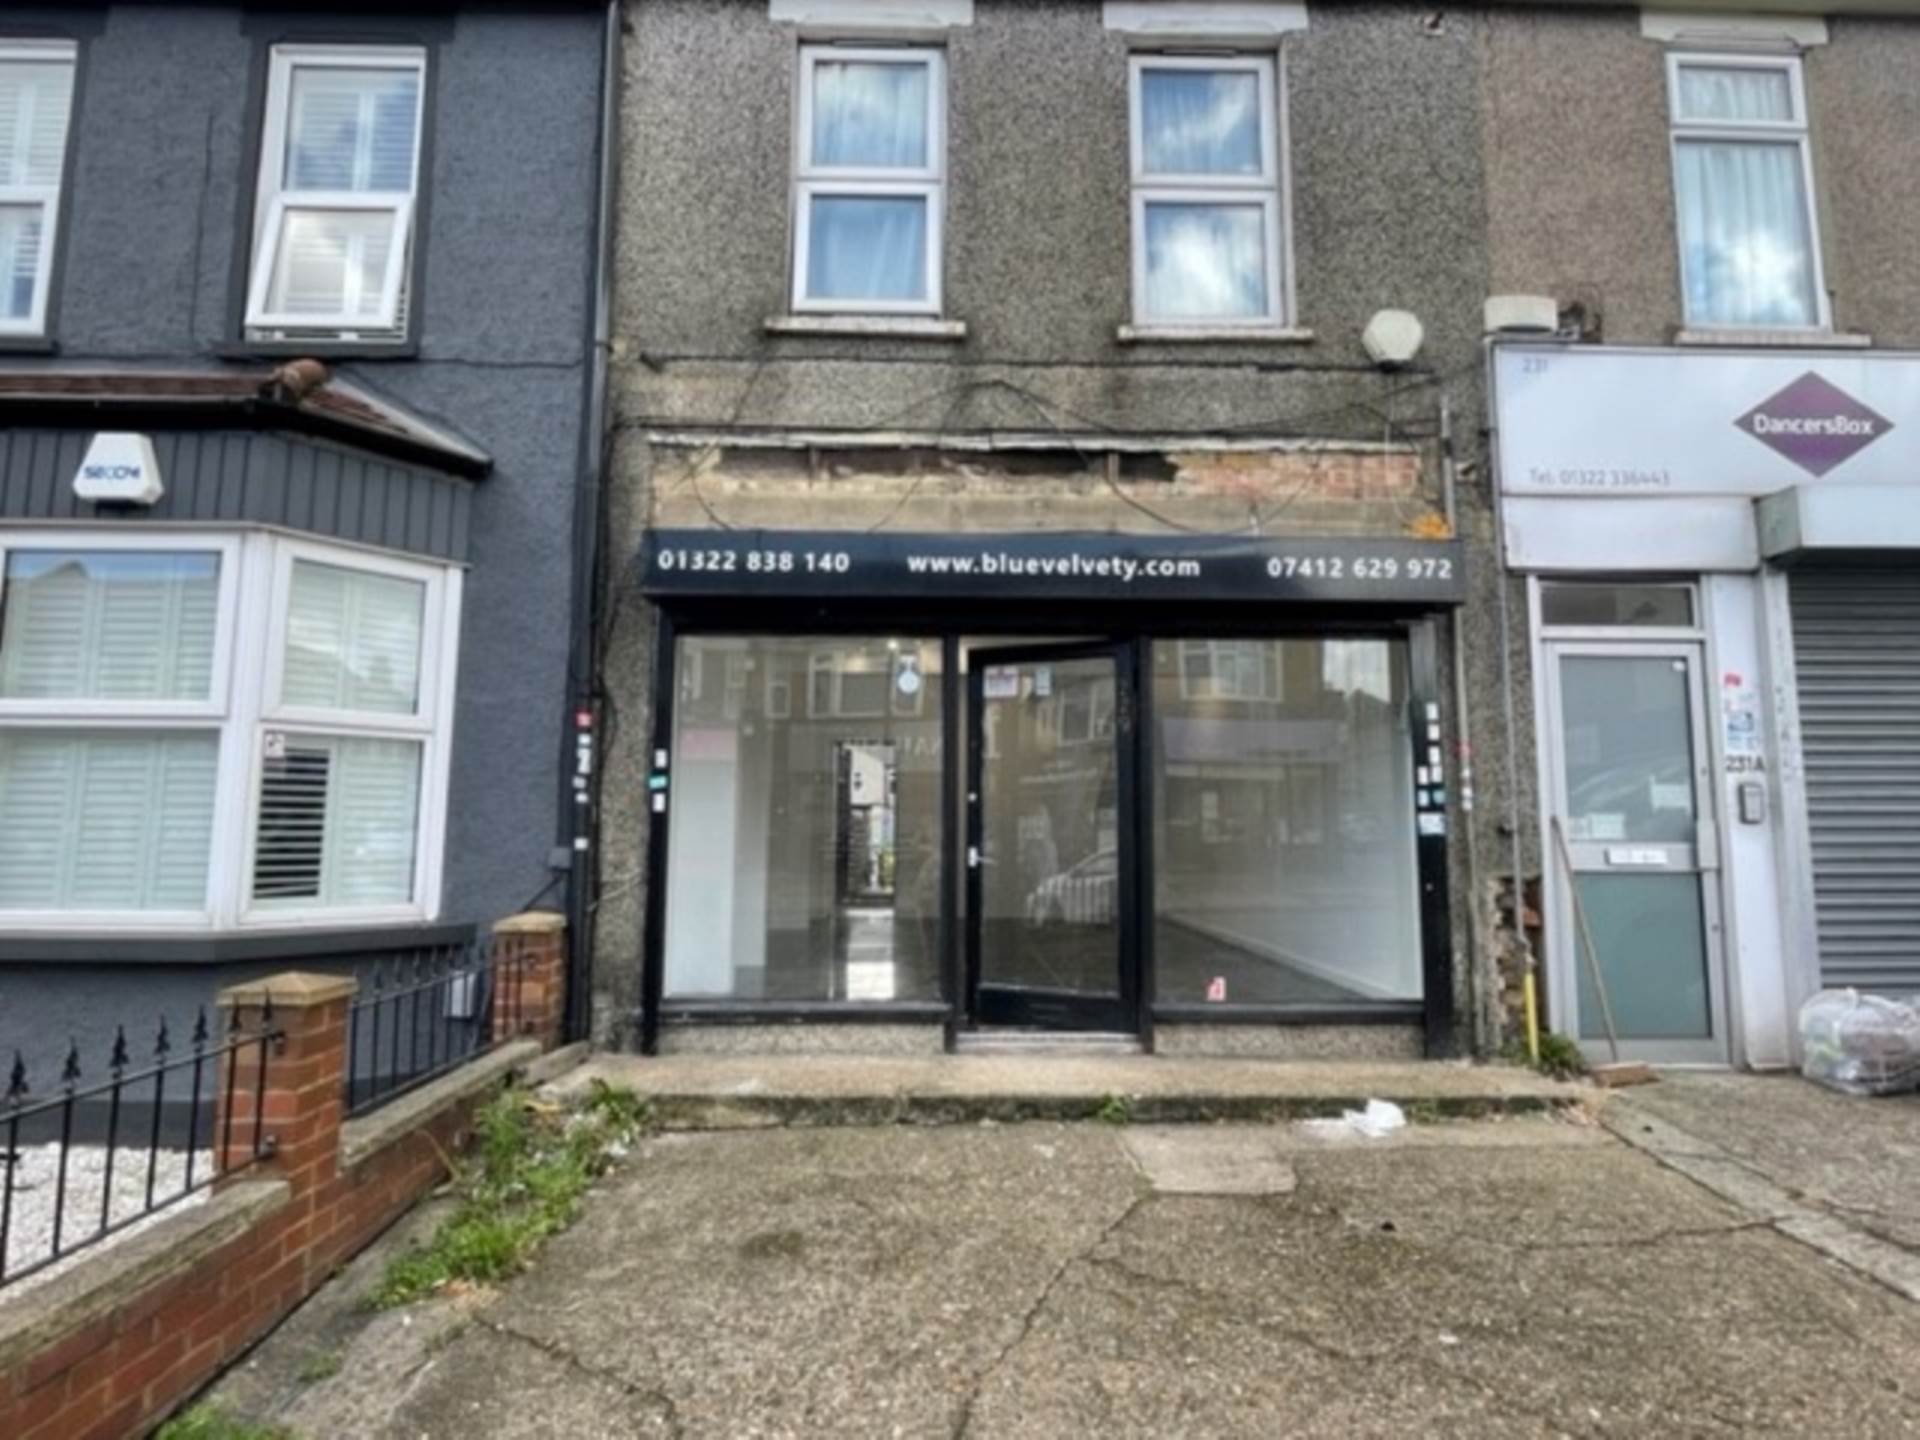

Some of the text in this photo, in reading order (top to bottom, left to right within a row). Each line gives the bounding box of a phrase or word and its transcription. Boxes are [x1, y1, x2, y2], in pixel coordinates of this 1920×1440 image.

[1753, 413, 1874, 437] DancersBox
[1559, 469, 1606, 485] 01322
[657, 549, 851, 574] 01322 838 140
[907, 553, 1201, 582] www.bluevelvety.com
[1266, 556, 1453, 580] 07412 629 972
[1725, 755, 1766, 773] 231A
